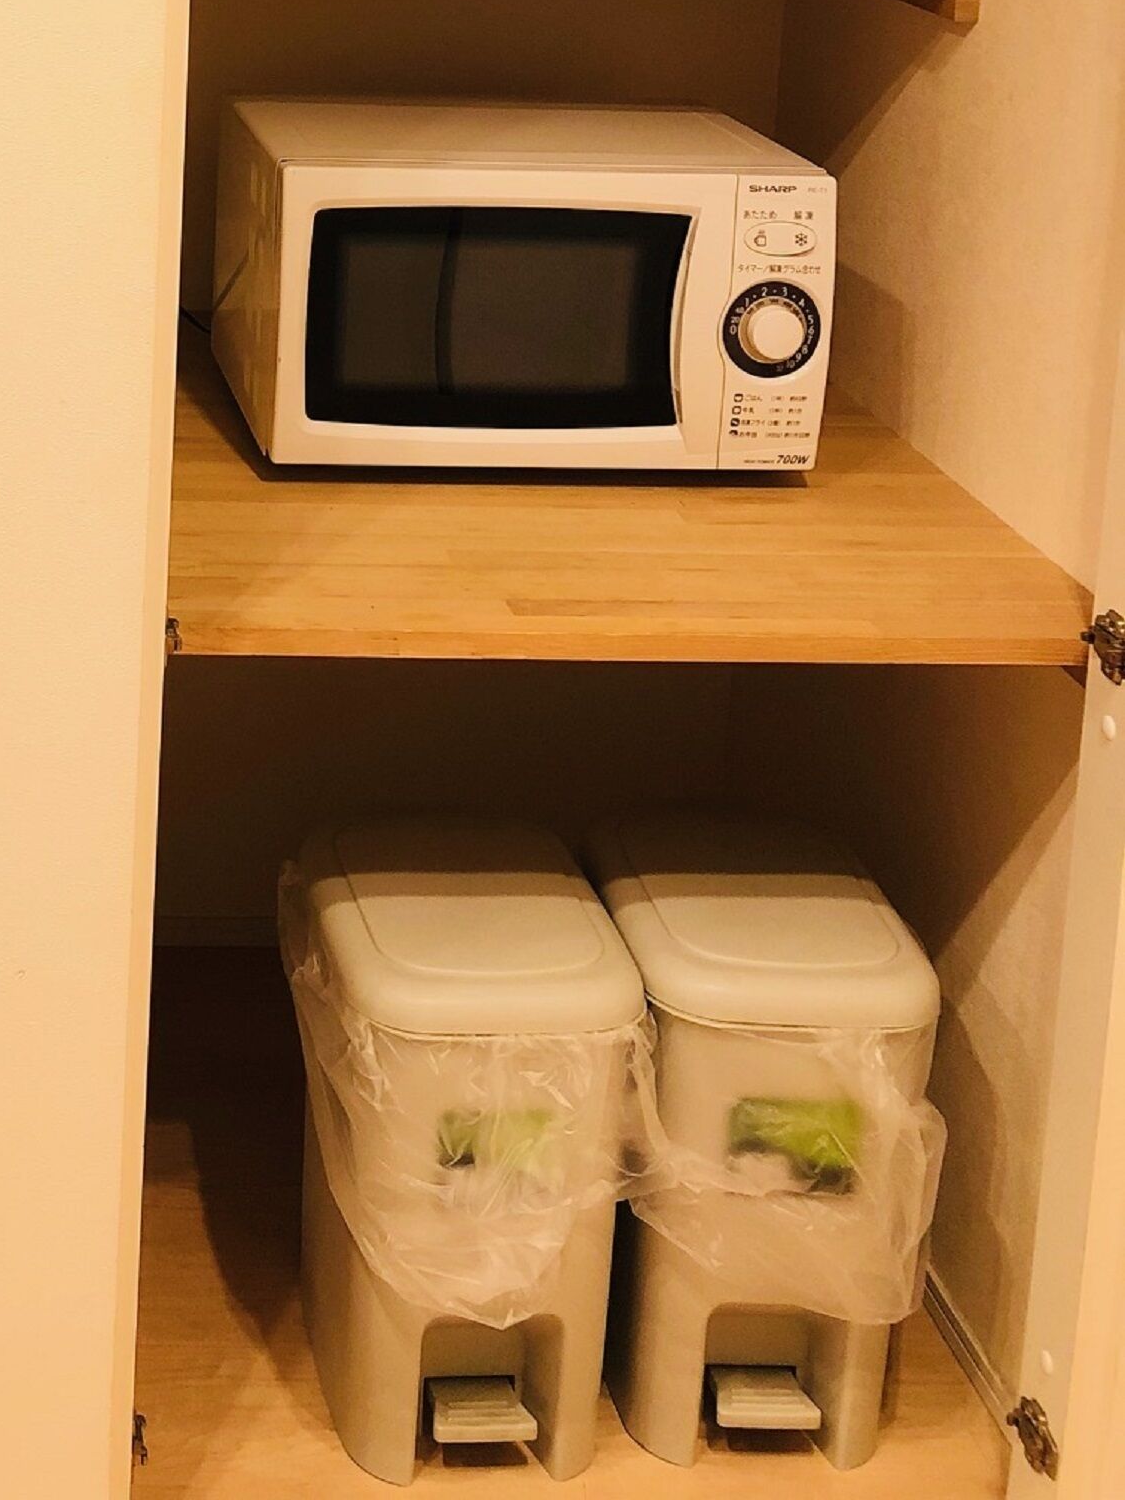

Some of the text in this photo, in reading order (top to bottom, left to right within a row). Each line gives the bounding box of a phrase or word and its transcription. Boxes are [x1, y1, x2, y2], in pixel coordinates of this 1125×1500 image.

[749, 185, 798, 193] SHARP
[743, 210, 778, 220] あたため
[761, 286, 768, 297] 2
[782, 286, 789, 297] 3
[807, 314, 815, 325] 5
[729, 324, 738, 336] 0
[807, 325, 816, 336] 6
[776, 454, 810, 465] 700W
